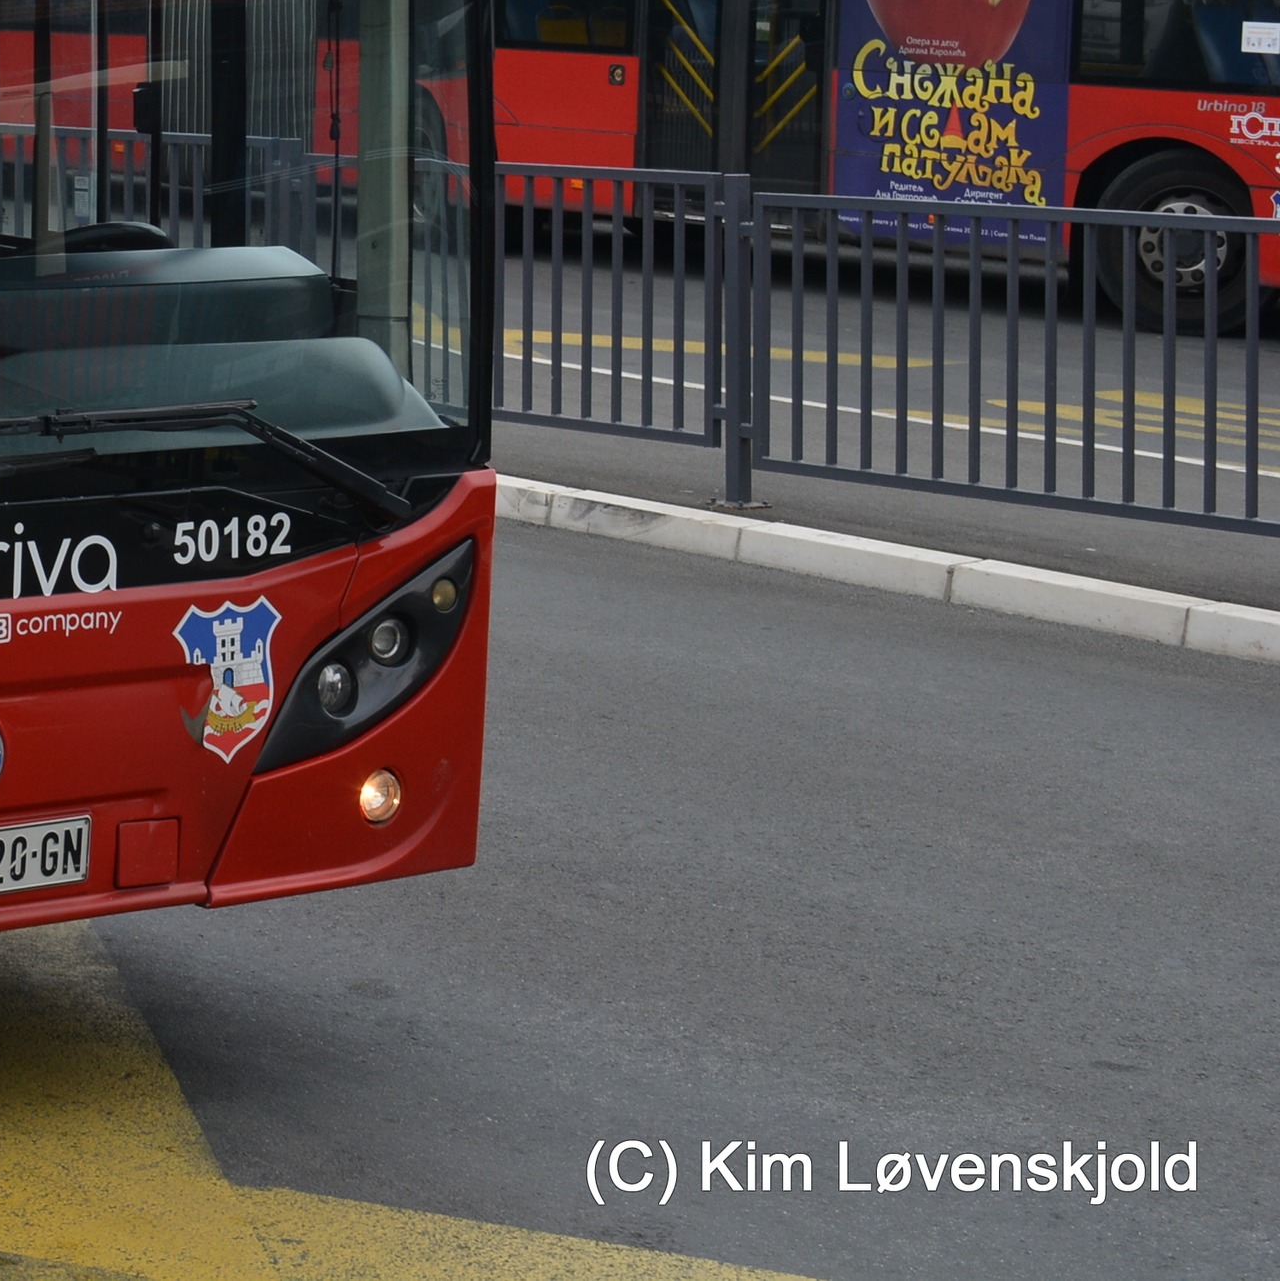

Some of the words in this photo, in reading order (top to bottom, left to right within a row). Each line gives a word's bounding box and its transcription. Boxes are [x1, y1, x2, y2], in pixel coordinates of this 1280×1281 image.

[906, 36, 931, 47] Опера
[932, 39, 940, 47] за
[941, 38, 959, 49] децу
[898, 45, 928, 56] Драгана
[928, 46, 967, 58] Каролића
[852, 38, 1041, 120] Снежана
[1197, 99, 1248, 114] Urbino
[1251, 101, 1266, 115] 18
[963, 188, 1003, 201] Диригент
[173, 511, 292, 565] 50182
[15, 610, 122, 637] company
